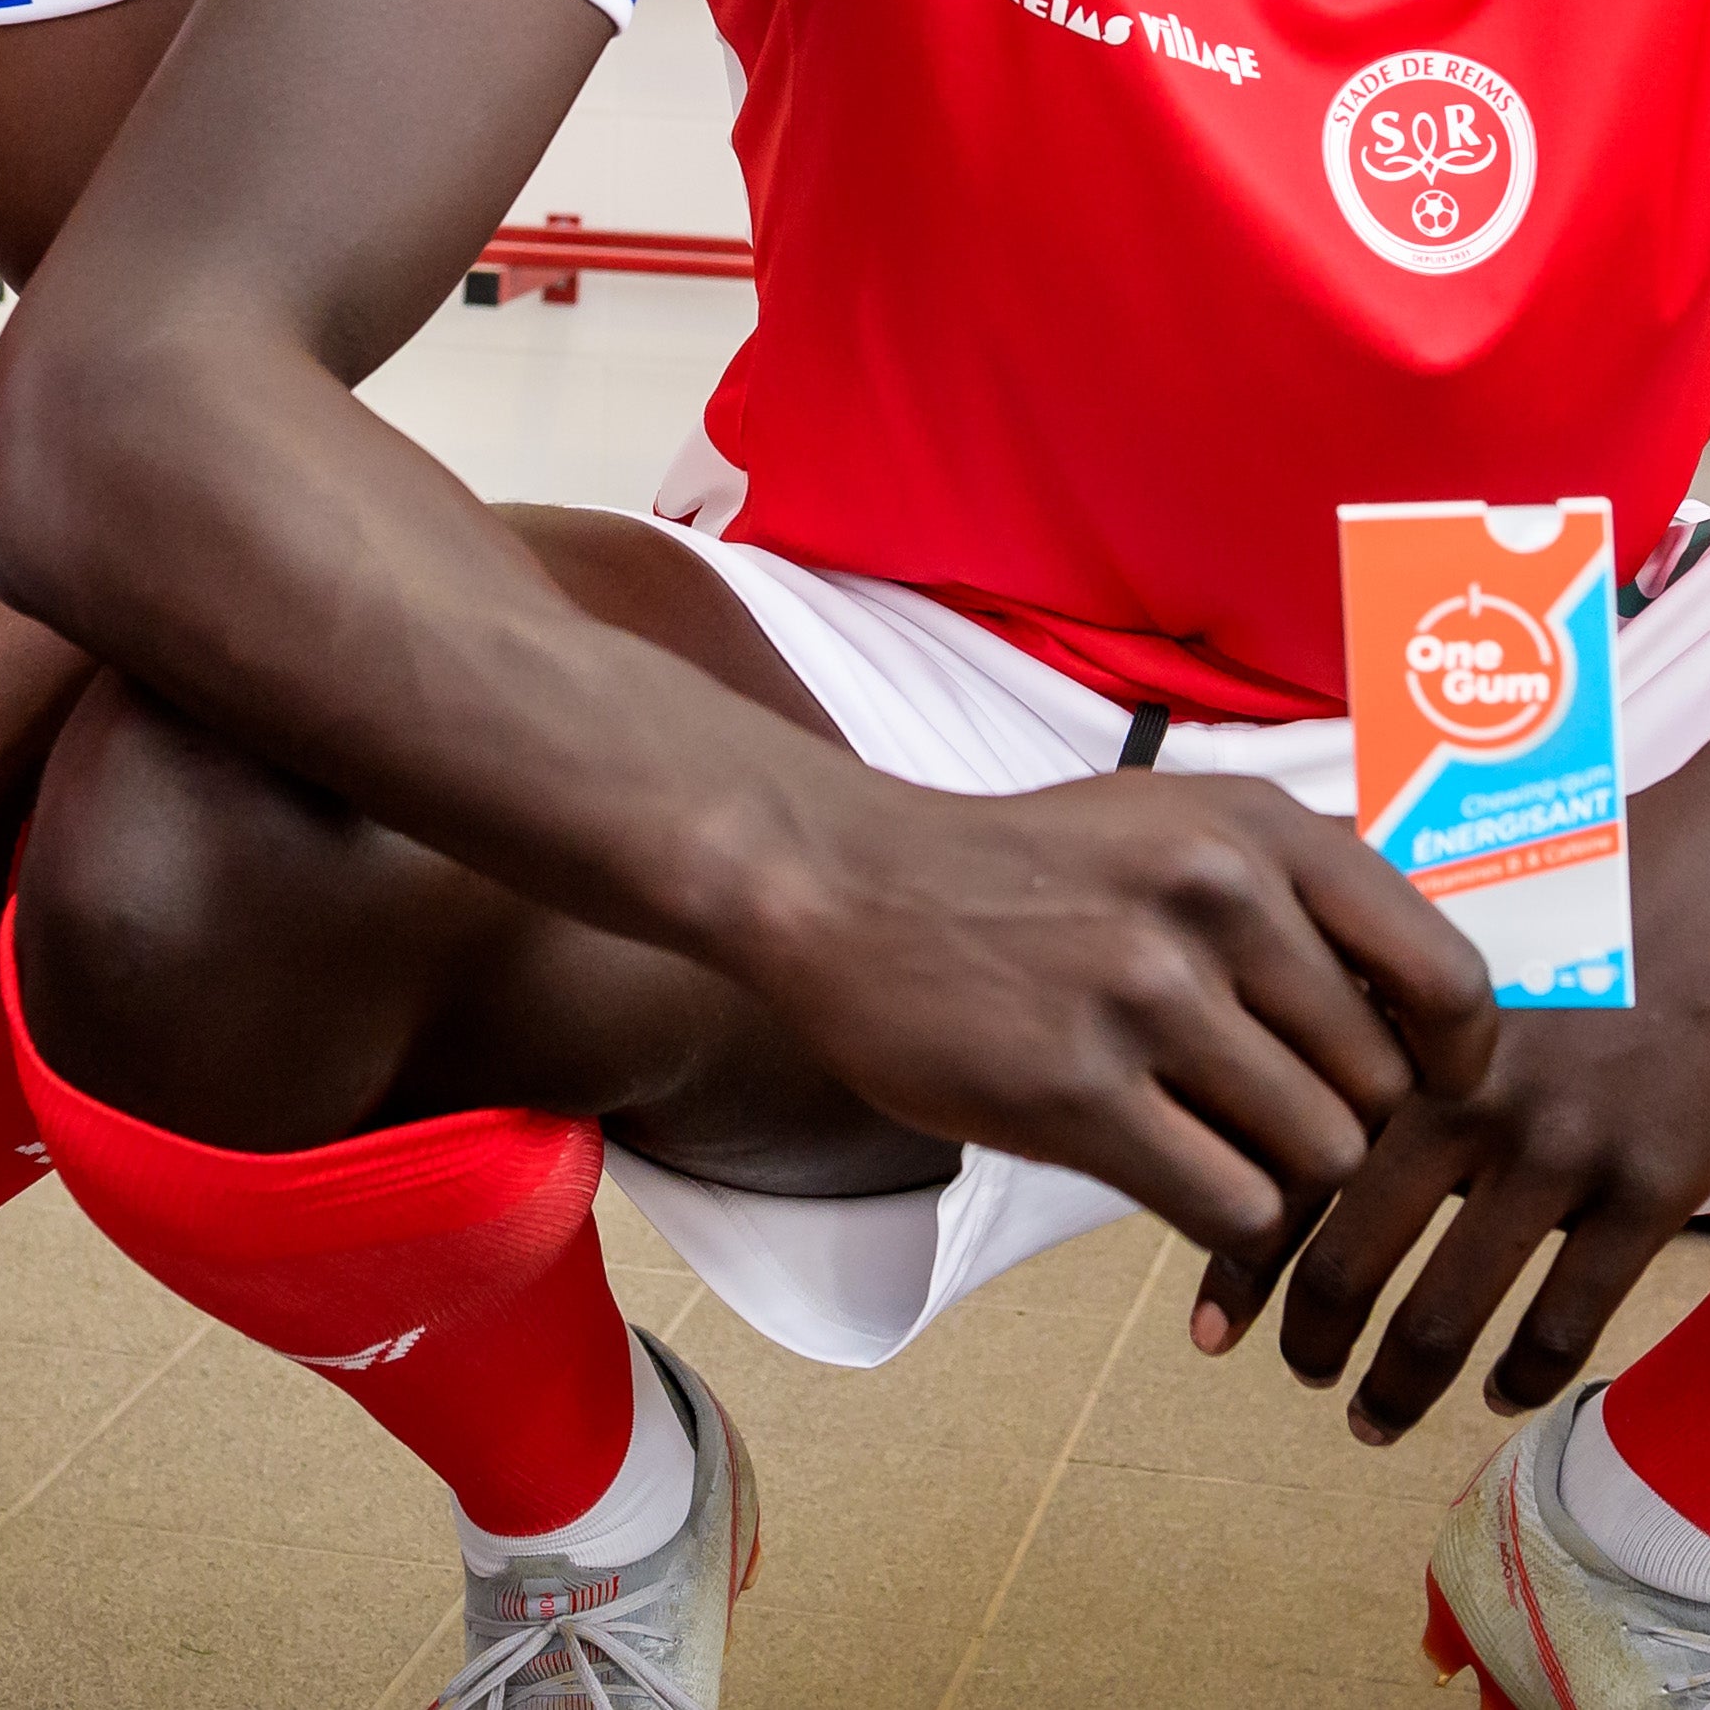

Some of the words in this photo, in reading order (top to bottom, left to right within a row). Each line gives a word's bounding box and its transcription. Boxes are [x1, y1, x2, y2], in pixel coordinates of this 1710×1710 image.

[1333, 64, 1394, 128] STADE
[1402, 57, 1434, 77] DE
[1444, 59, 1515, 112] REIMS
[1405, 634, 1504, 672] One
[1442, 669, 1550, 705] Gum
